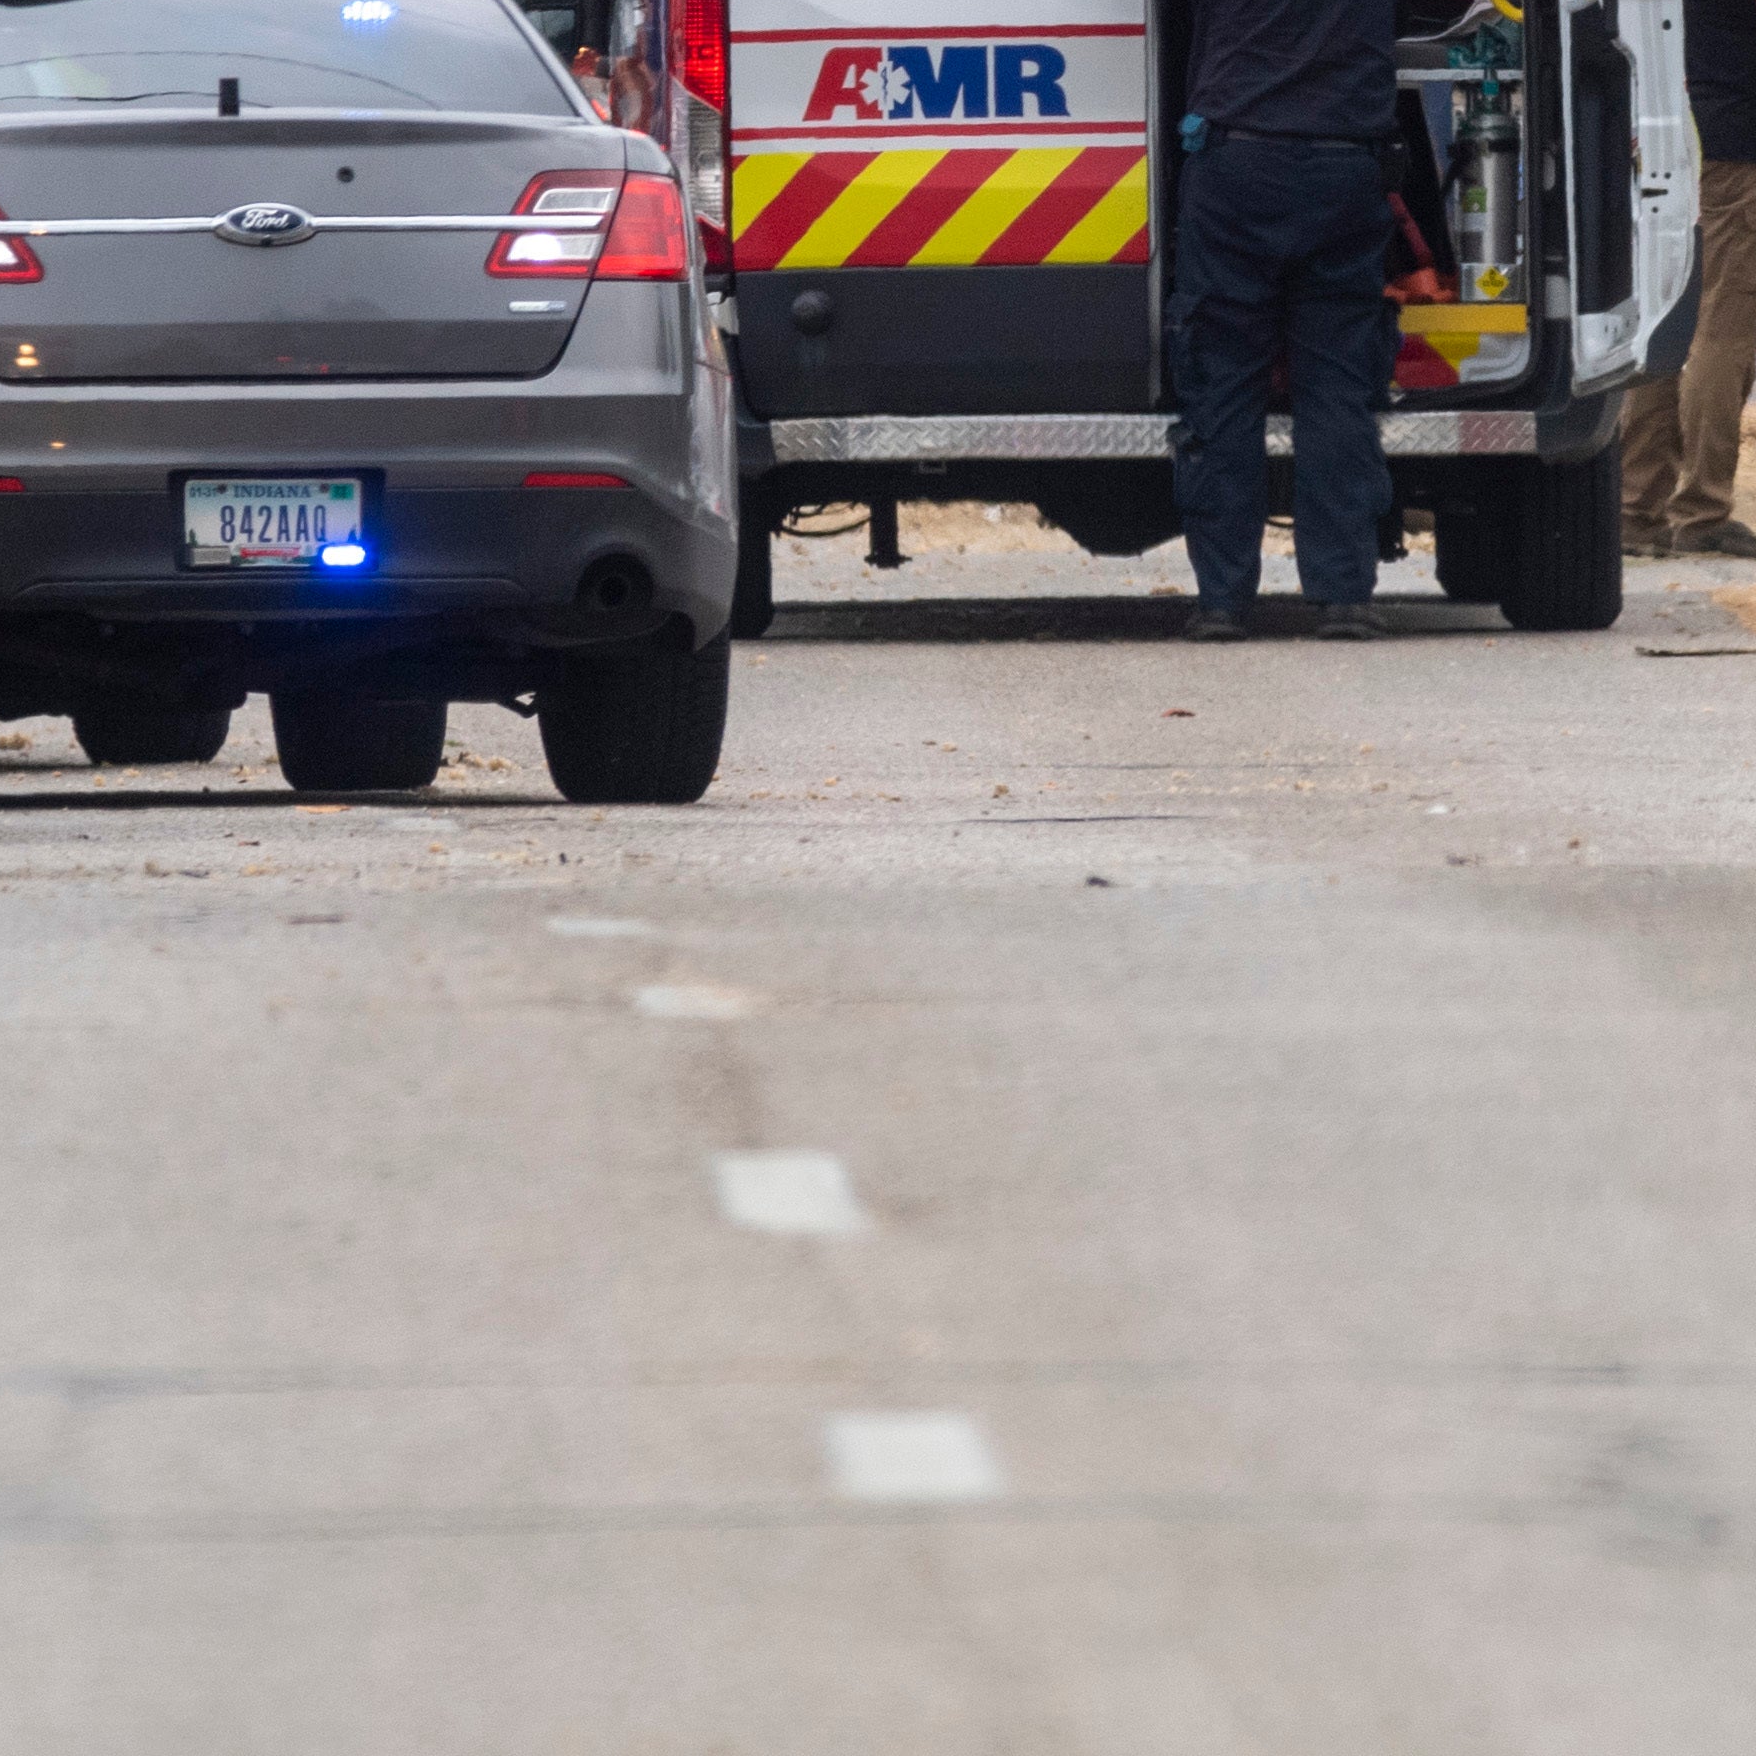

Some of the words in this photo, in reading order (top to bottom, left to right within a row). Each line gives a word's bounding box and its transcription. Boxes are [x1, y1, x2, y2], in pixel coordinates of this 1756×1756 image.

[802, 44, 1071, 121] AMR
[242, 208, 291, 229] Ford
[233, 484, 312, 498] INDIANA
[219, 503, 327, 544] 842AAQ
